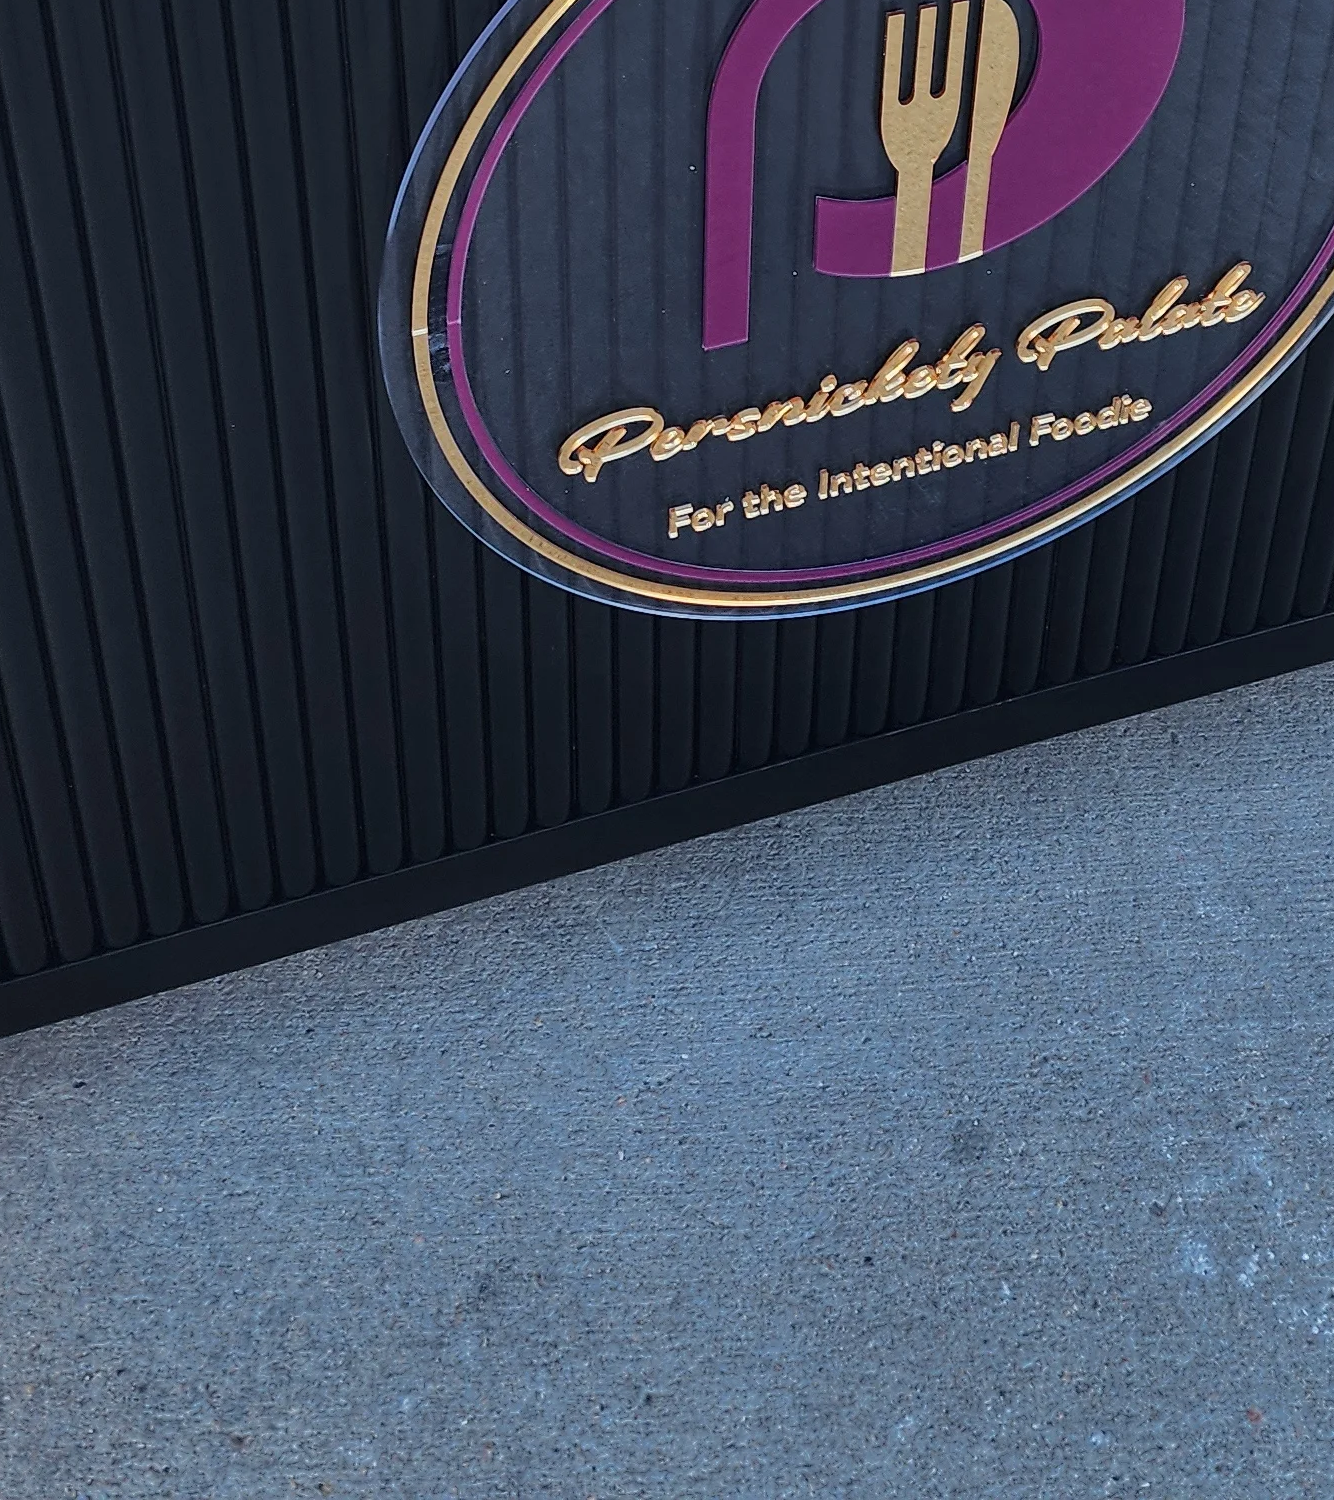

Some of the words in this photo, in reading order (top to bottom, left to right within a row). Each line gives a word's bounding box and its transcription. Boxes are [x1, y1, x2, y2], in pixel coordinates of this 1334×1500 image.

[558, 322, 1002, 483] Persnickety
[1016, 261, 1266, 371] Palate
[668, 497, 734, 539] For
[743, 483, 807, 520] the
[818, 421, 1020, 500] Intentional
[1029, 394, 1154, 447] Foodie
